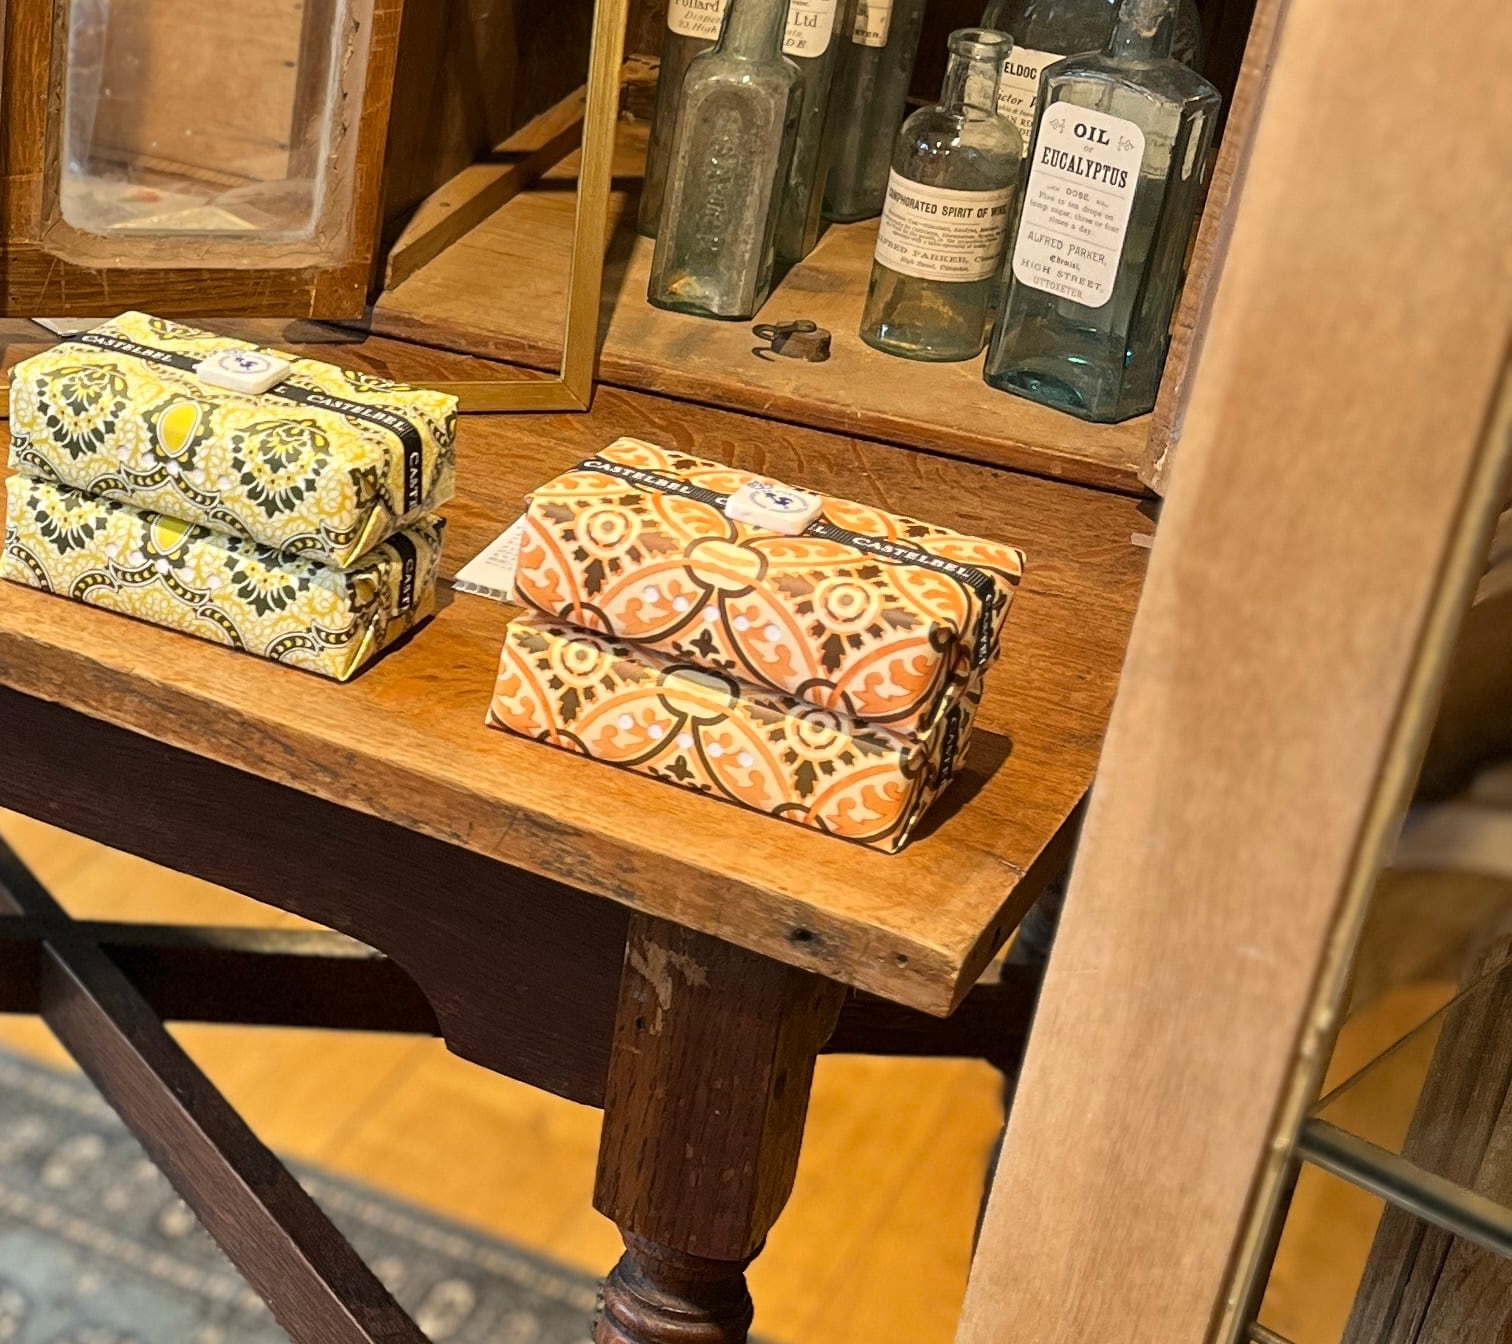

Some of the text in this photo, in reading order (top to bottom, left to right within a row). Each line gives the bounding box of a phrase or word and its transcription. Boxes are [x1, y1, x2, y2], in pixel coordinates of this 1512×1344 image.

[794, 11, 818, 28] Ltd
[1003, 61, 1037, 80] ELDOC
[1073, 123, 1111, 146] OIL
[1040, 146, 1129, 189] EUCALYPTUS
[941, 205, 973, 218] SPIRIT
[977, 207, 988, 218] OF
[1027, 231, 1064, 250] ALFRED
[1020, 258, 1052, 274] HIGH
[81, 334, 174, 364] CASTELBEL
[306, 393, 407, 432] CASTELBEL
[583, 459, 692, 494] CASTELBEL
[852, 536, 970, 579] CASTELBEL
